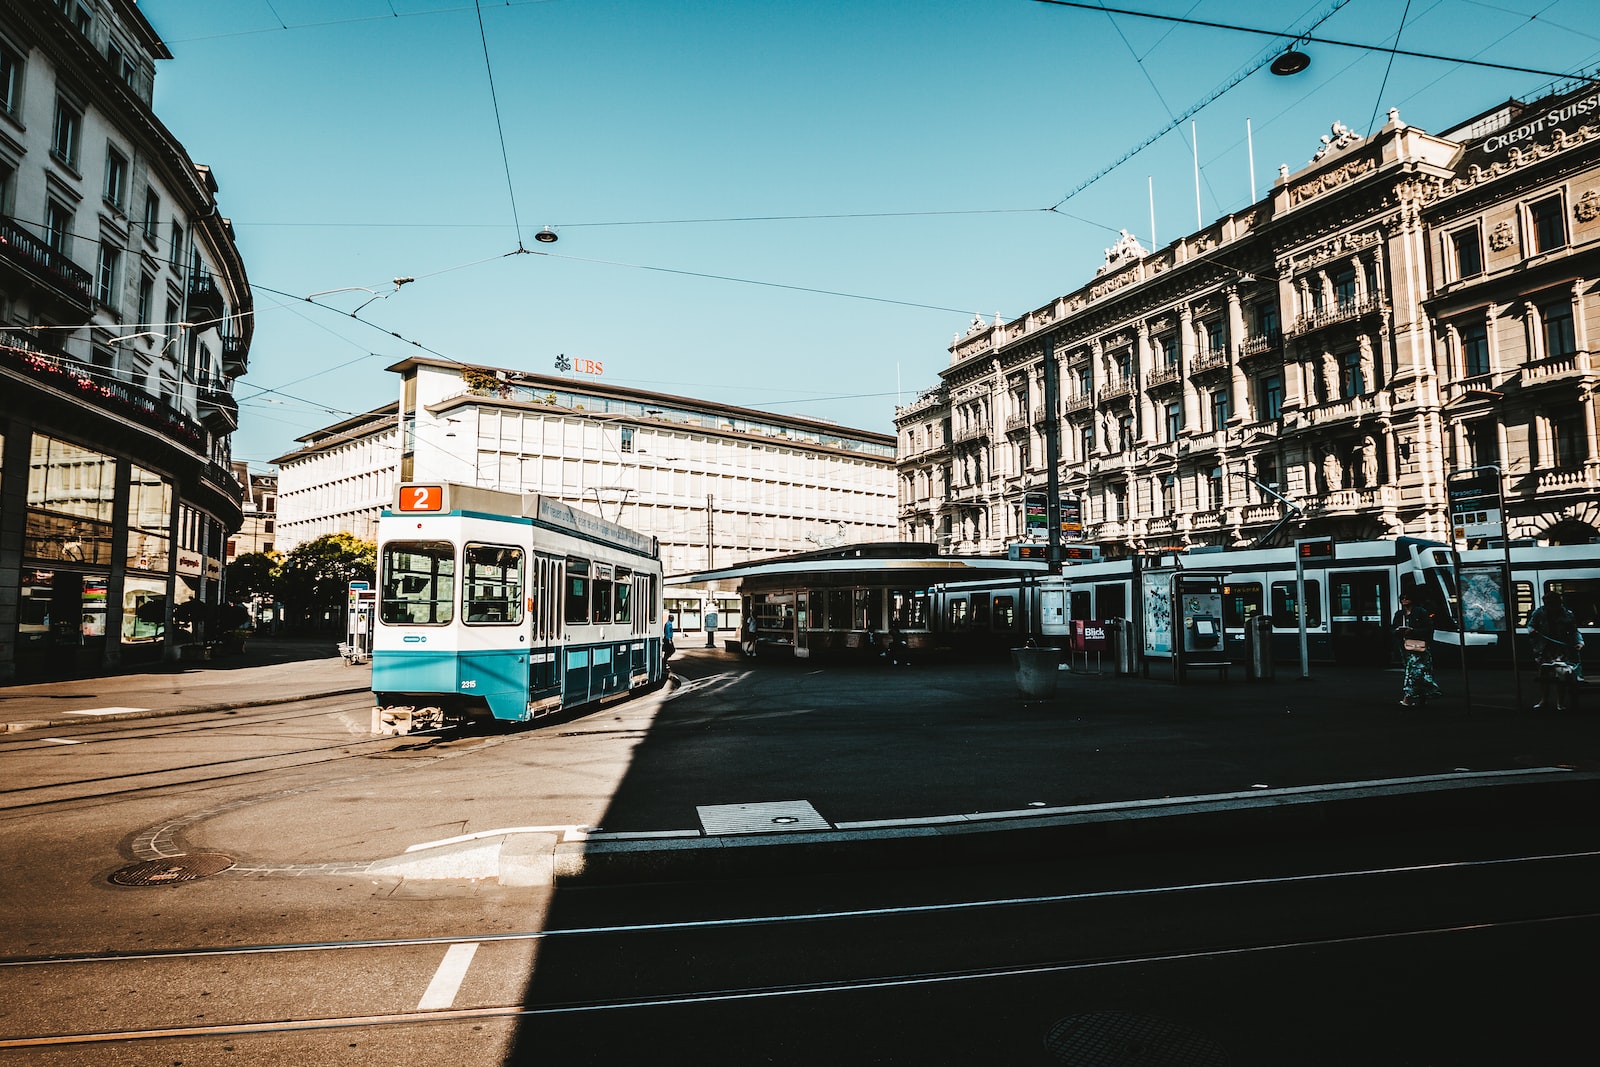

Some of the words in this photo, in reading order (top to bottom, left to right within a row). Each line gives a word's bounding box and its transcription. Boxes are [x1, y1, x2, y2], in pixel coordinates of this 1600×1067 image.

[1483, 115, 1547, 153] CREDIT
[574, 357, 604, 376] UBS
[413, 487, 429, 509] 2
[1455, 504, 1464, 512] 11
[1084, 626, 1105, 636] Blick
[461, 680, 477, 689] 2315
